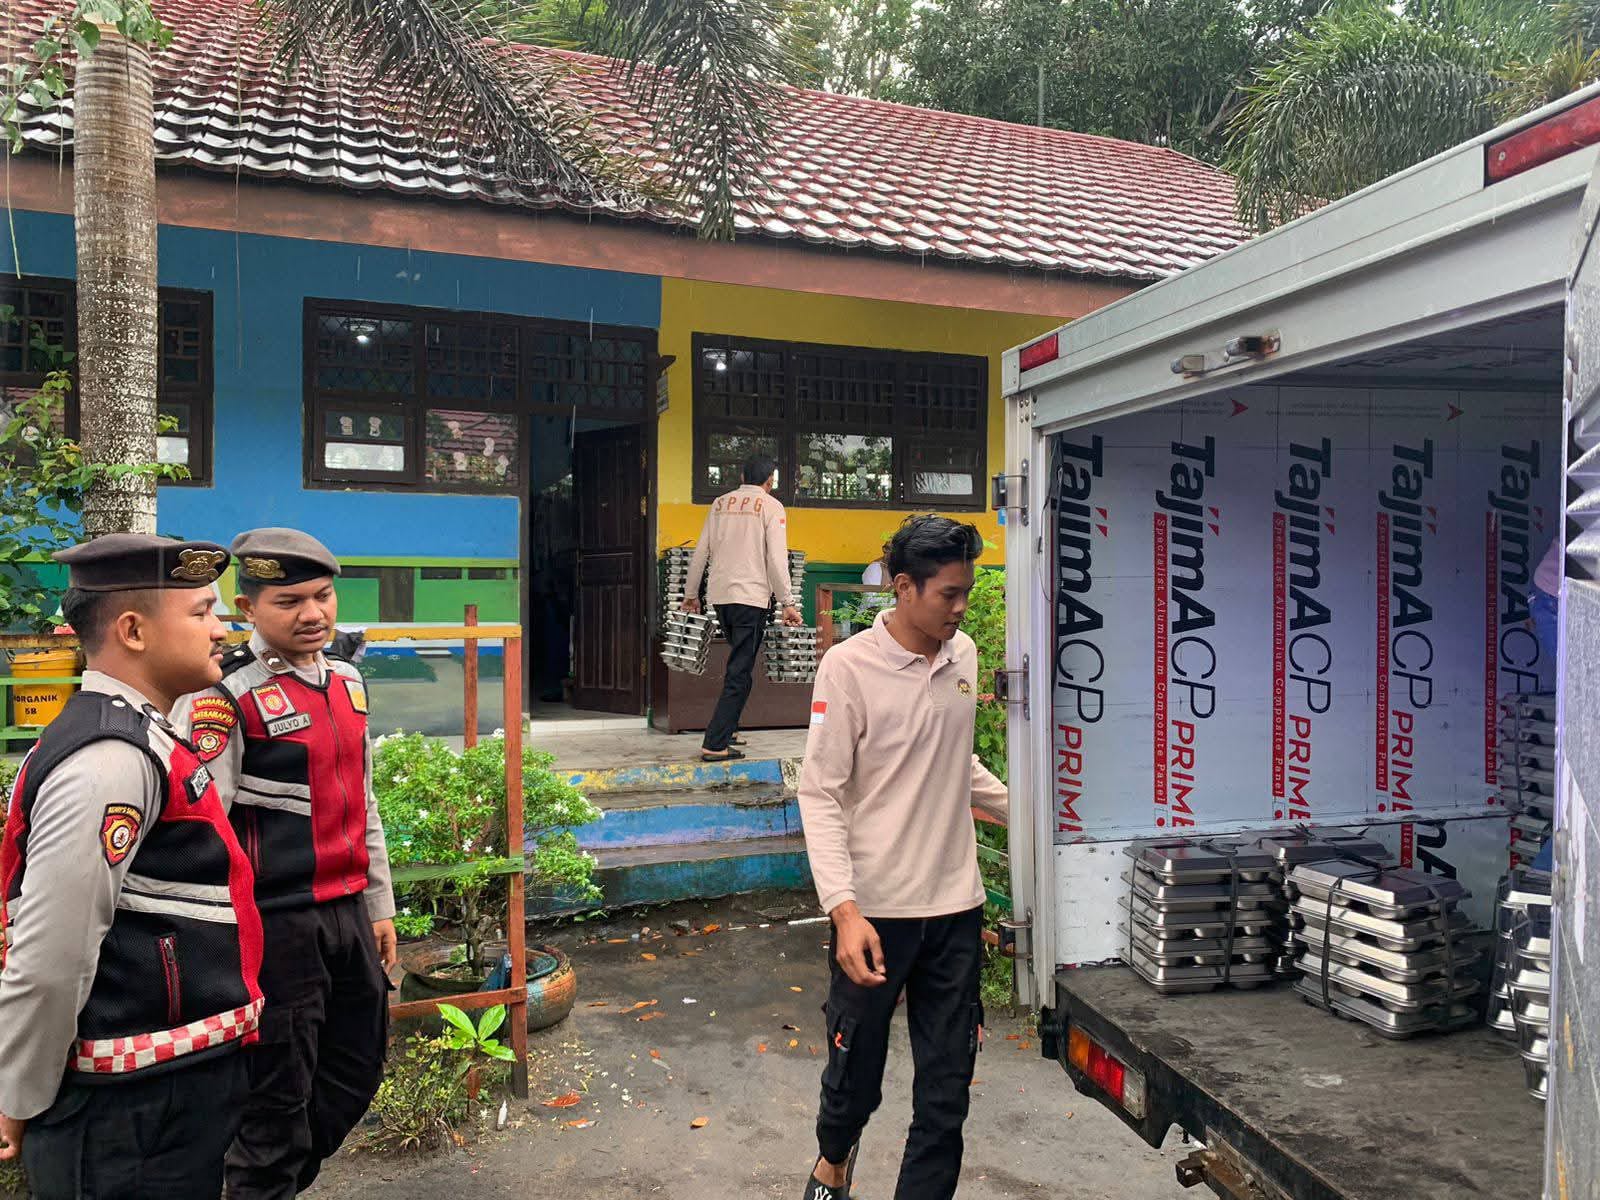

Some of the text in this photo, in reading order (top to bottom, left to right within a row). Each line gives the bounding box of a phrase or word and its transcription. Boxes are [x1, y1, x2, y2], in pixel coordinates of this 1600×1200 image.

[715, 496, 763, 512] SPPG
[1155, 435, 1219, 719] TajimACP
[1274, 437, 1336, 714] TajimACP
[1378, 438, 1437, 709] TajimACP
[272, 717, 309, 734] JULYO A
[1155, 518, 1166, 802] Specialist Aluminium Composite Panel
[1273, 517, 1285, 796] Specialist Aluminium Composite Panel
[1376, 518, 1388, 789] Specialist Aluminium Composite Panel
